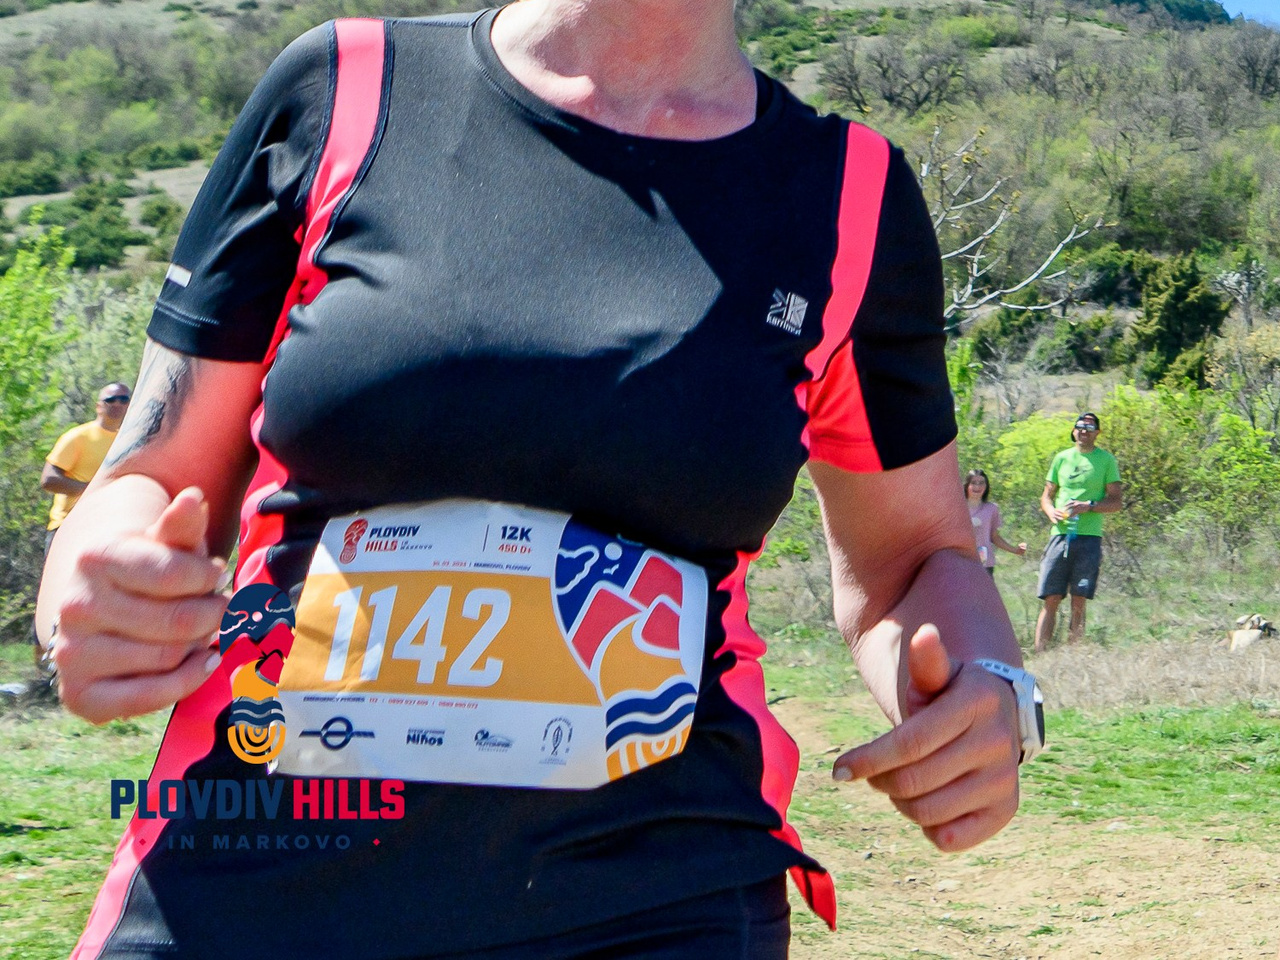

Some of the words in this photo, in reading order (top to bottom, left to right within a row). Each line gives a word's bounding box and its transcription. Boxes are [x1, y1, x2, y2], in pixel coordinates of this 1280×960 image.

[369, 525, 421, 539] PLOVDIV
[501, 526, 533, 542] 12K
[365, 540, 398, 552] HILLS
[323, 585, 511, 688] 1142
